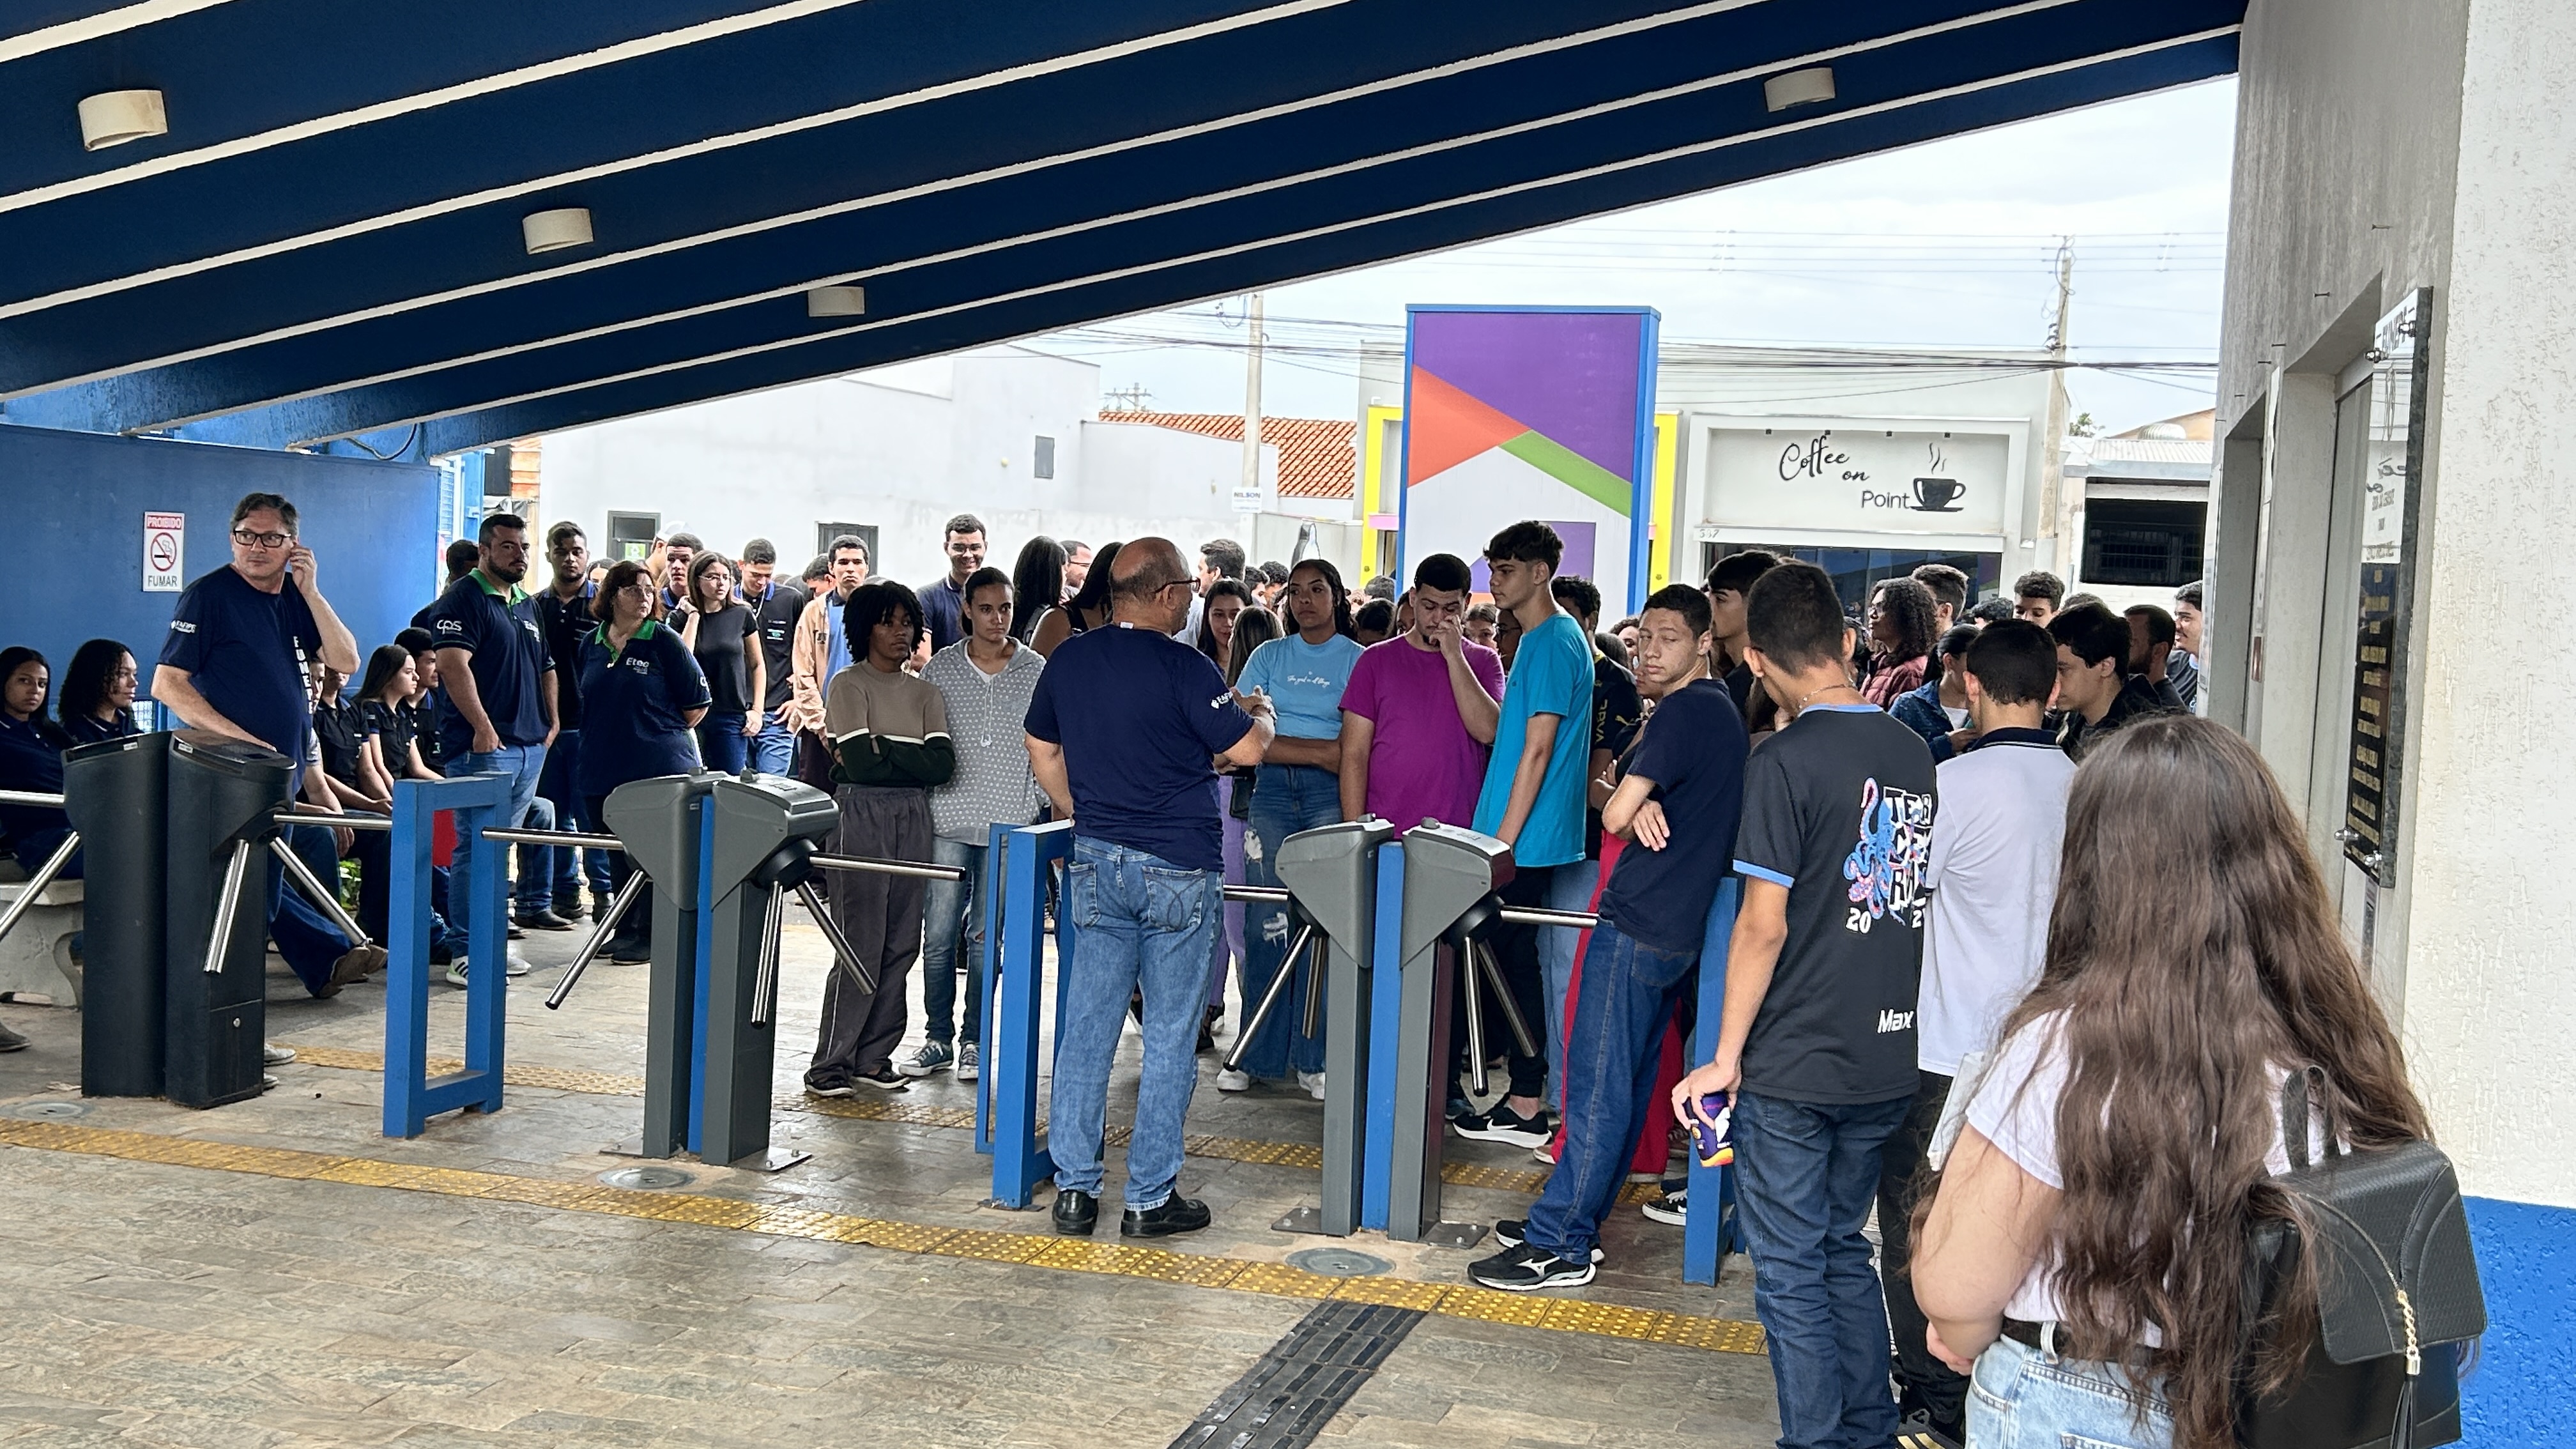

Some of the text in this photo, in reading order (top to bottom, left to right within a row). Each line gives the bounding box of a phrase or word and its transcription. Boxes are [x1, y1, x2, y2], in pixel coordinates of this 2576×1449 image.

[1779, 435, 1850, 481] Coffee
[1842, 471, 1870, 481] on
[1861, 490, 1910, 509] Point
[147, 516, 181, 528] PROIBIDO
[148, 575, 178, 587] FUMAR
[1846, 907, 1926, 934] 20 2
[1876, 1009, 1914, 1034] Max
